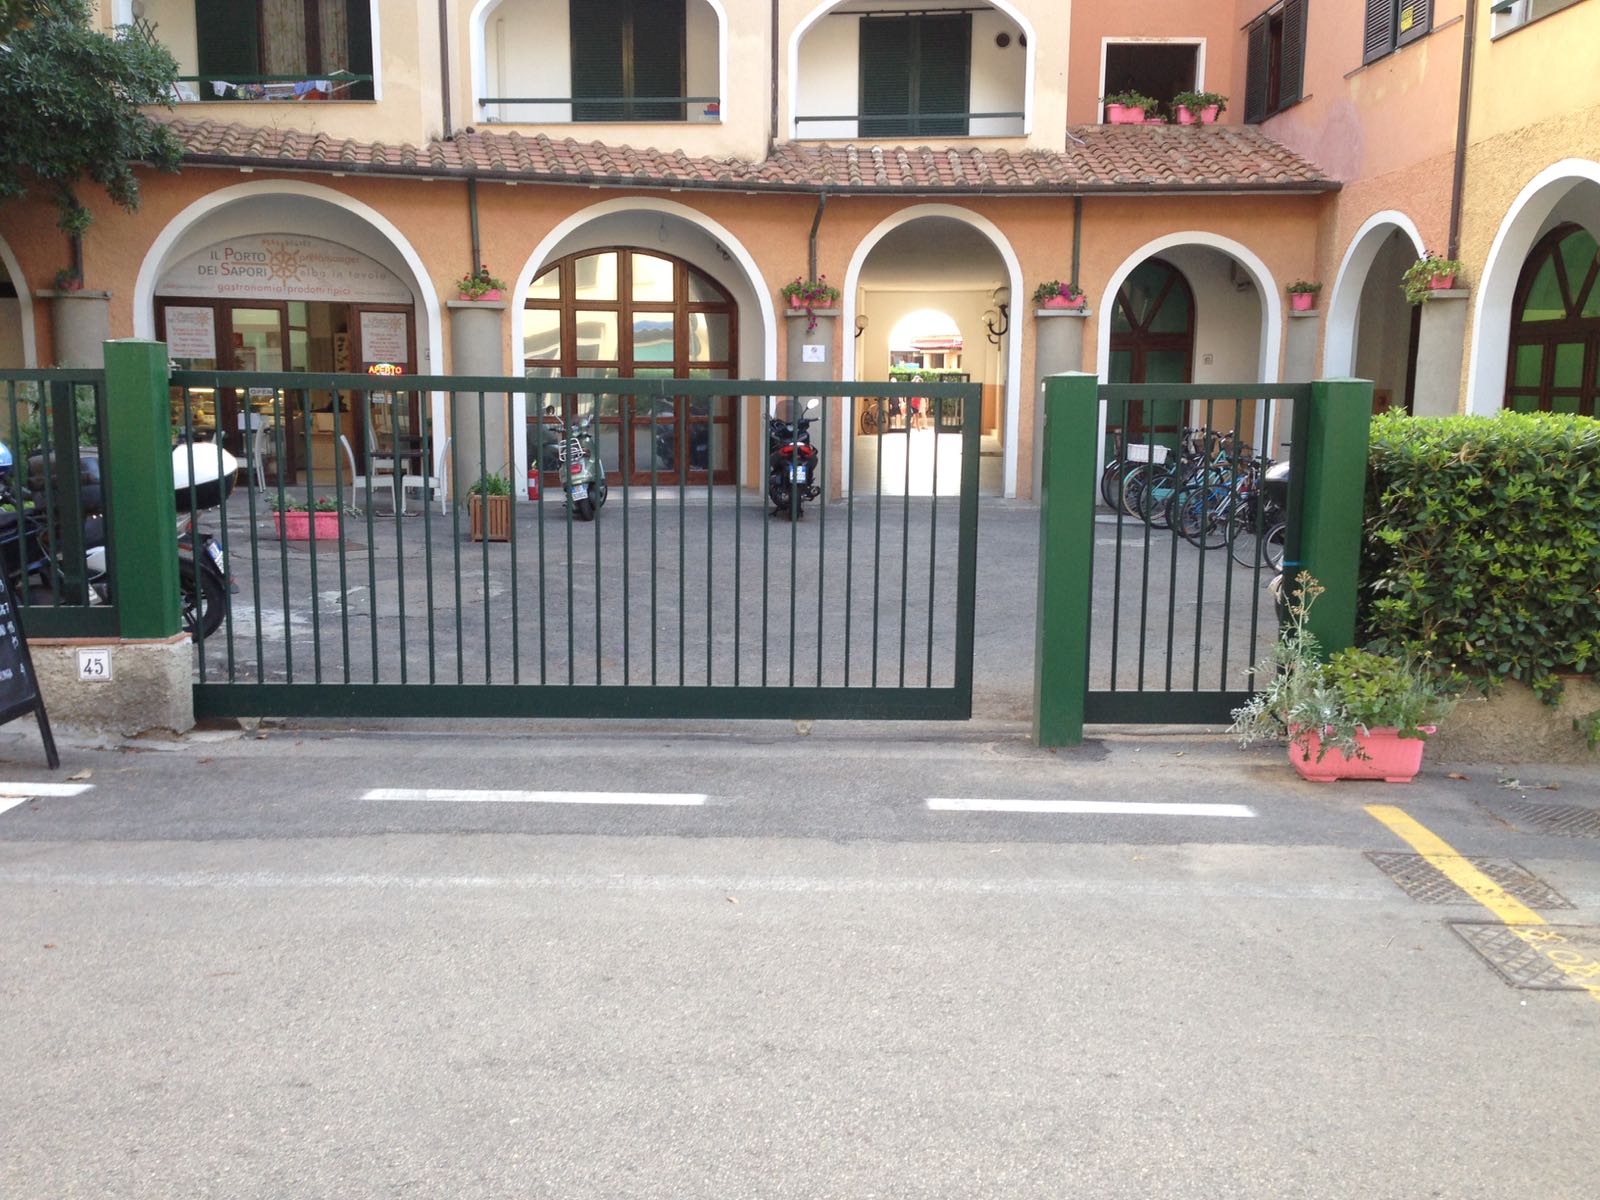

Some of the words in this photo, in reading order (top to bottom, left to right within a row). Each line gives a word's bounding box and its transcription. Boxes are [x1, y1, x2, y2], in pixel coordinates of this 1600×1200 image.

[210, 250, 221, 261] IL
[224, 247, 266, 262] PORTO
[198, 265, 217, 276] DEI
[221, 263, 267, 277] SAPORI
[217, 283, 282, 293] gastronomia
[287, 285, 326, 295] prodotti
[327, 286, 352, 296] tipici
[368, 365, 403, 375] APERTO
[83, 658, 104, 675] 45
